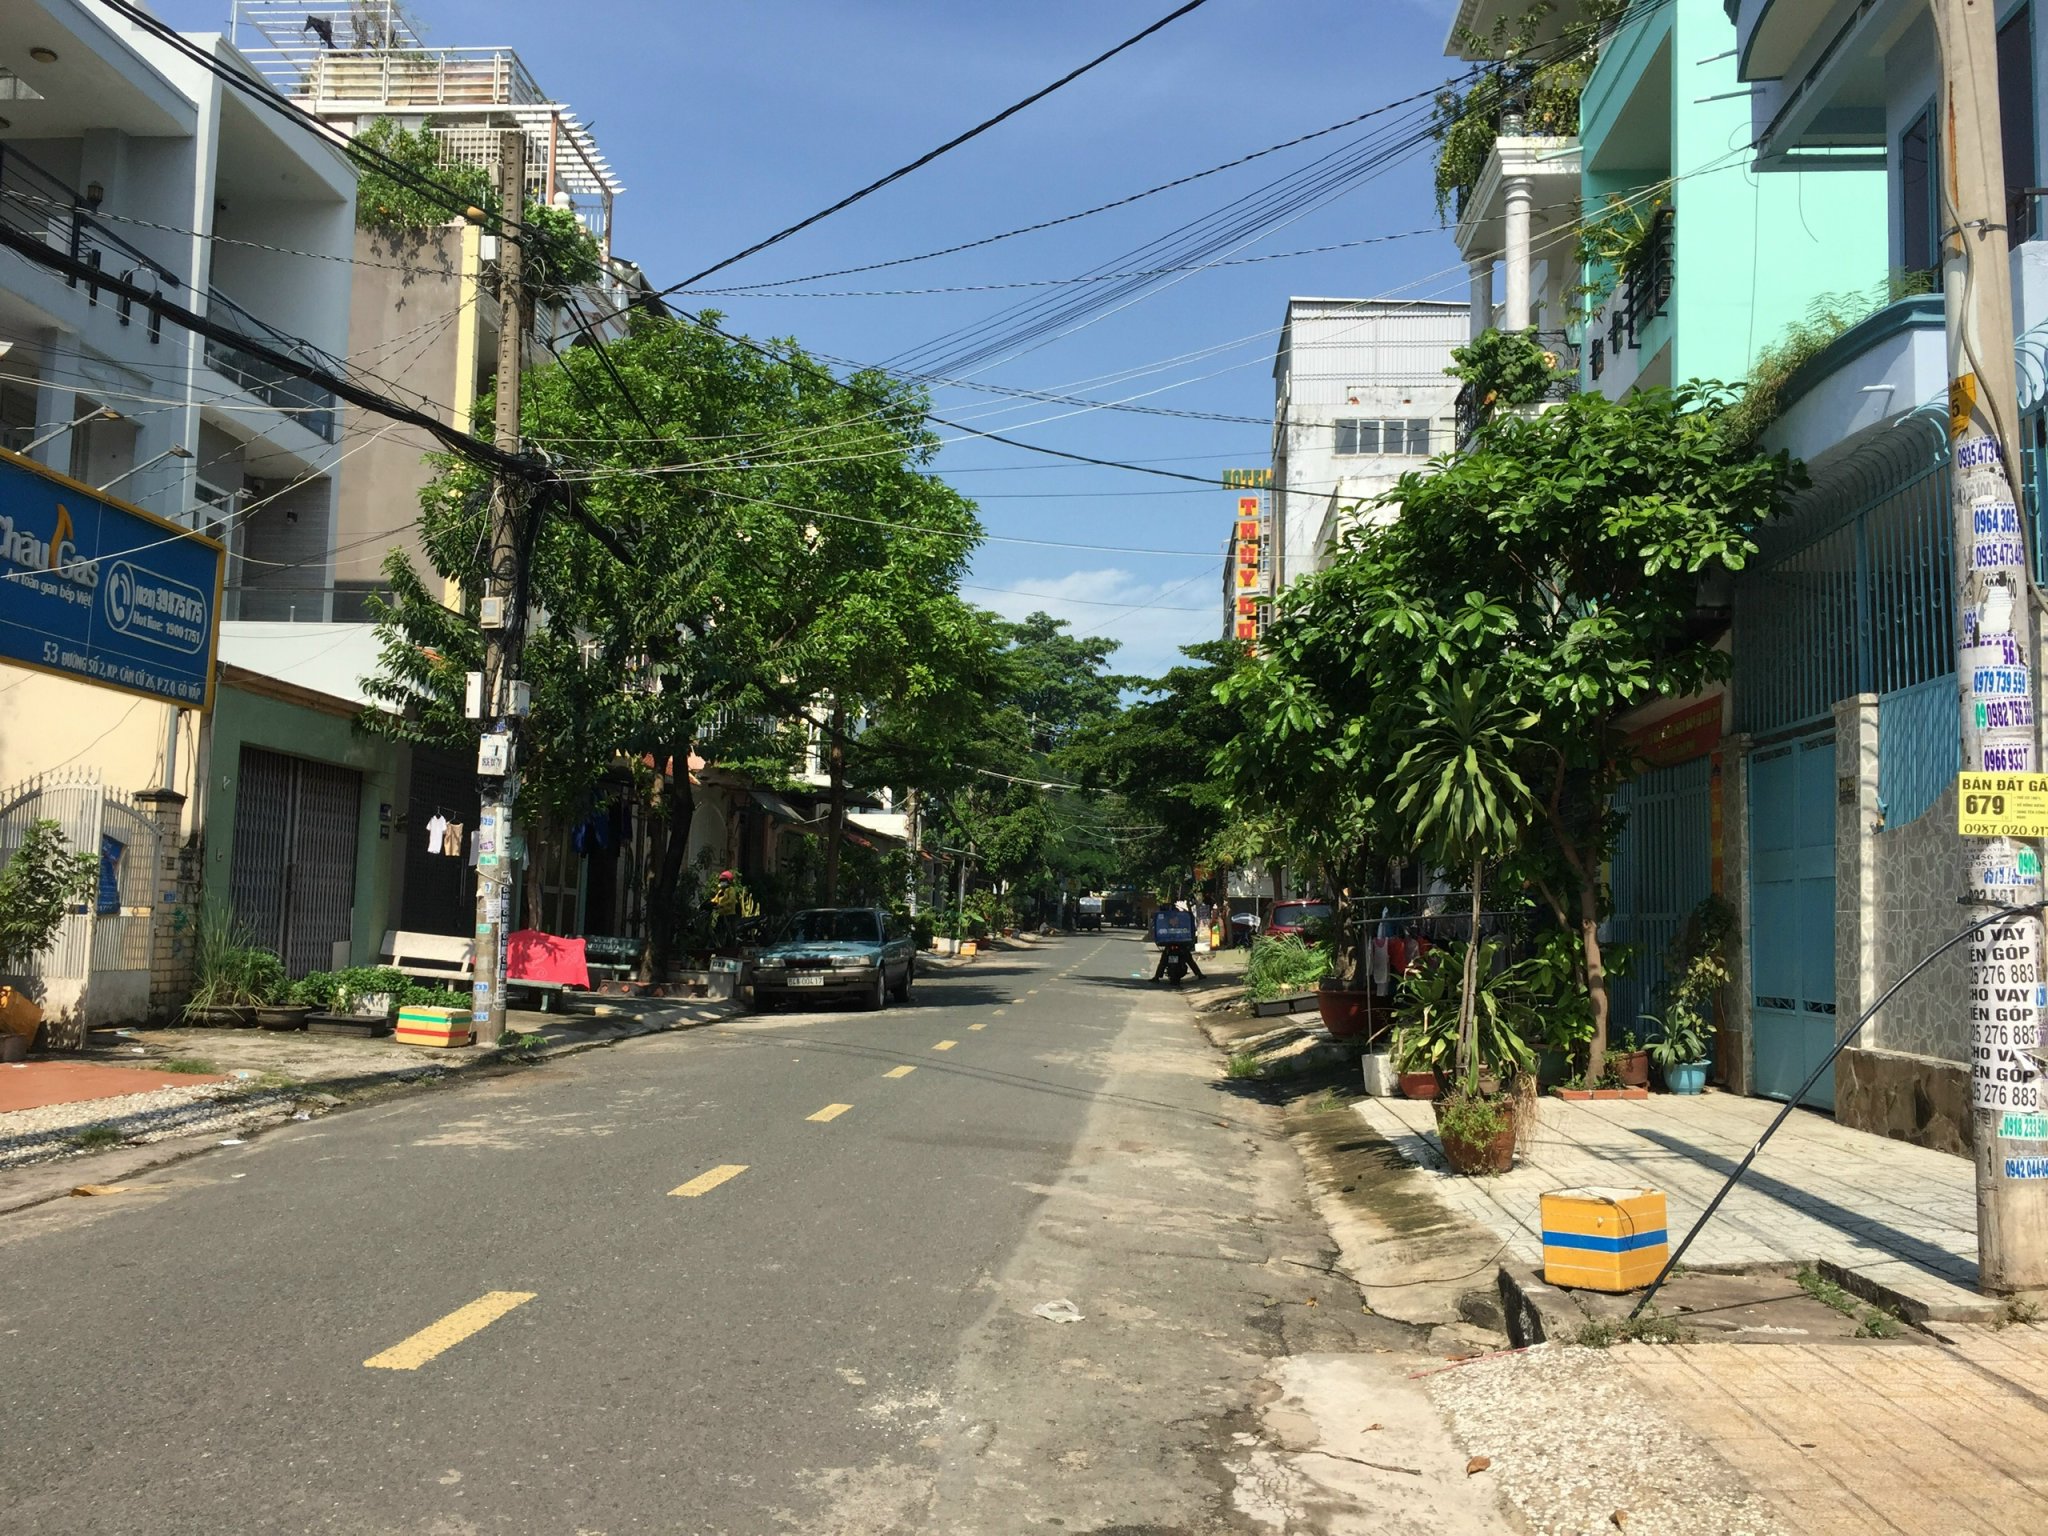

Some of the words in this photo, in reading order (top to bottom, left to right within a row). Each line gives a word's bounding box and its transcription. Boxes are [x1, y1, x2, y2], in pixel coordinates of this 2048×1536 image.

[1958, 444, 1976, 469] 0935
[1978, 441, 1994, 463] 473
[1975, 508, 1998, 535] 0964
[56, 541, 99, 588] Gas
[1976, 543, 1998, 568] 0935
[40, 582, 58, 596] gian
[43, 641, 59, 664] 53
[1974, 671, 2026, 694] 0979.739.559
[1962, 776, 1992, 791] BÁN
[1997, 775, 2024, 792] ĐẤT
[1966, 795, 2005, 815] 679
[1990, 927, 2025, 942] VAY
[1992, 943, 2029, 961] GÓP
[1982, 965, 2006, 985] 276
[2010, 963, 2034, 984] 883
[1995, 988, 2029, 1002] VAY
[1996, 1005, 2033, 1021] GÓP
[1984, 1025, 2008, 1046] 276
[2013, 1025, 2035, 1045] 883
[1997, 1049, 2018, 1062] VA
[1973, 1060, 1990, 1079] ẾN
[1996, 1066, 2035, 1084] GÓP
[1984, 1084, 2007, 1105] 276
[2012, 1086, 2037, 1107] 883
[2005, 1159, 2025, 1178] 0942
